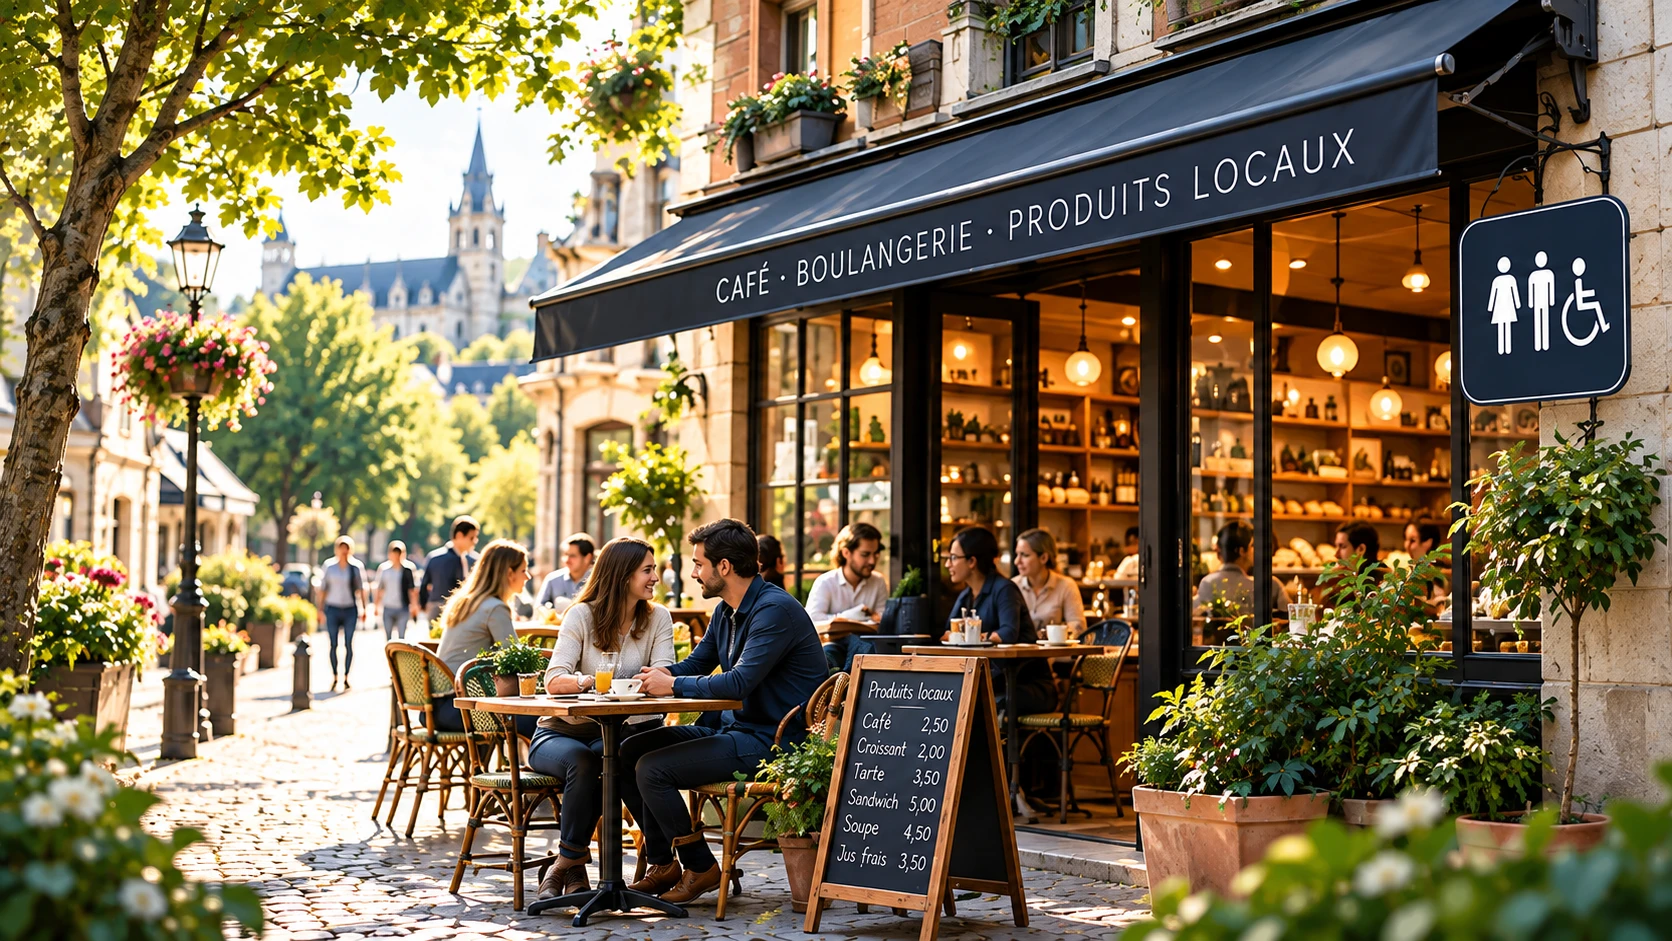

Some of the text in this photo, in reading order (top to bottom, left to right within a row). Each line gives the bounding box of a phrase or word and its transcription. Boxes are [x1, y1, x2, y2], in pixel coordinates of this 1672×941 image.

[716, 128, 1355, 304] CAFÉ BOULANGERIE PRODUITS LOCAUX
[868, 681, 953, 701] Produits locaux
[863, 712, 948, 735] Café 2,50
[858, 737, 945, 761] Croissant 2,00
[855, 763, 940, 787] Tarte 3,50
[848, 789, 936, 816] Sandwich 5,00
[843, 814, 931, 844] Soupe 4,50
[837, 844, 926, 873] Jus frais 3,50
